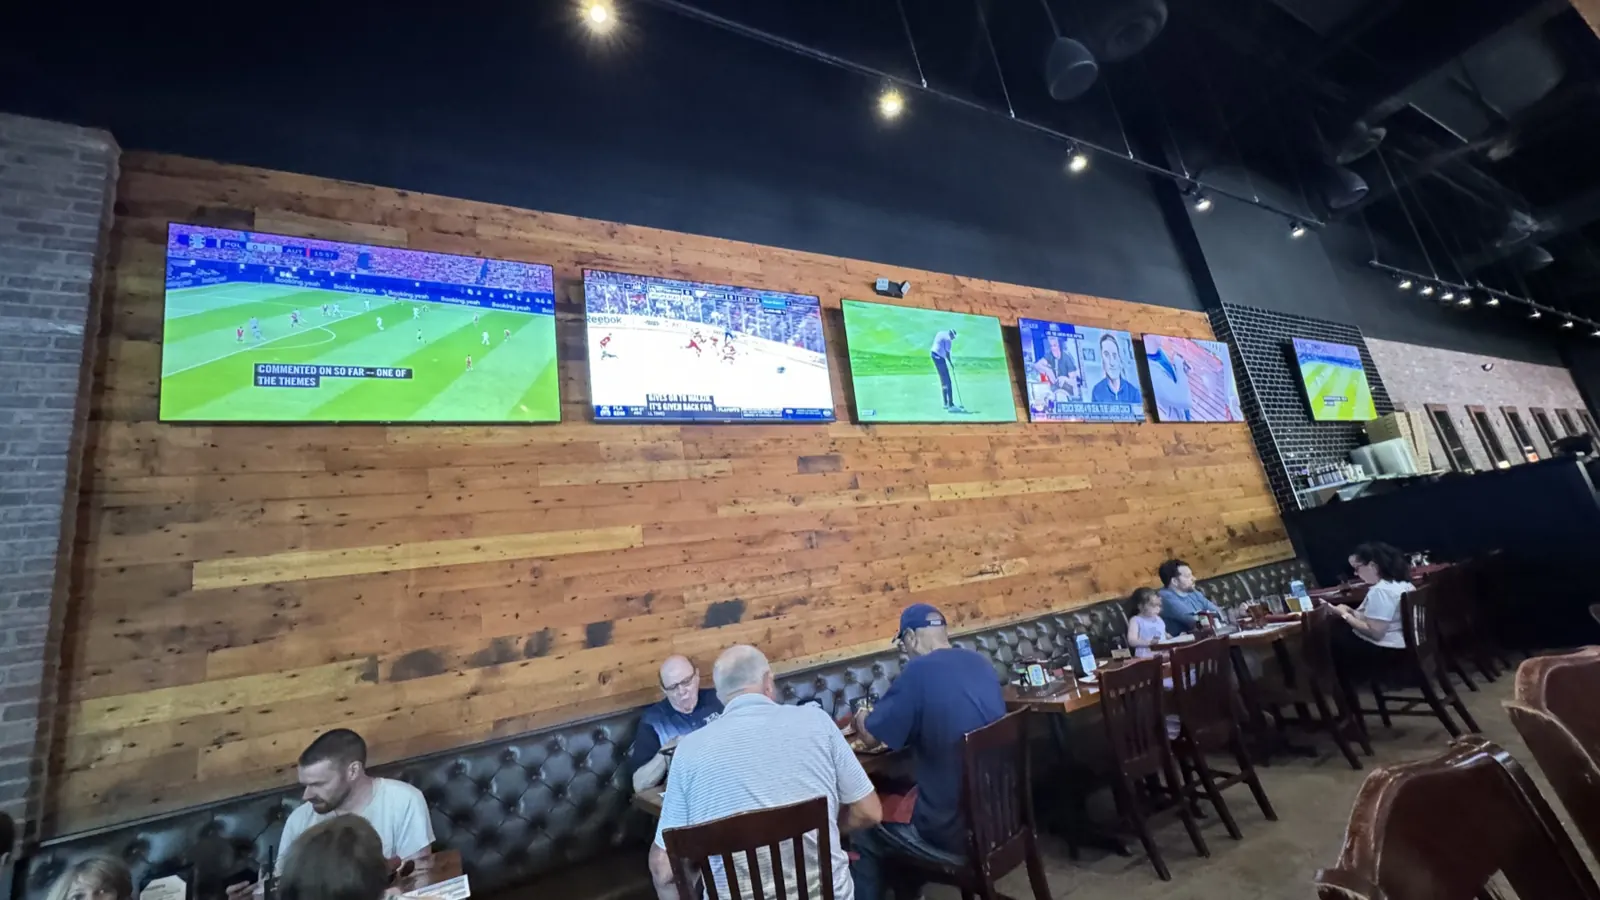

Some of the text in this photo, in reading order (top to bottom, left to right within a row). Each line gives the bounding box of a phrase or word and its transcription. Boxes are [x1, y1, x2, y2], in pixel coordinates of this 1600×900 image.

[224, 241, 242, 249] POL
[587, 315, 622, 324] Reebok
[258, 365, 317, 375] COMMENTED
[319, 366, 332, 375] ON
[334, 366, 346, 376] SO
[348, 367, 365, 377] FAR
[376, 368, 394, 377] ONE
[395, 369, 406, 378] OF
[258, 376, 316, 386] THE THEMES
[649, 402, 713, 411] IT'S GIVEN BACK FOR
